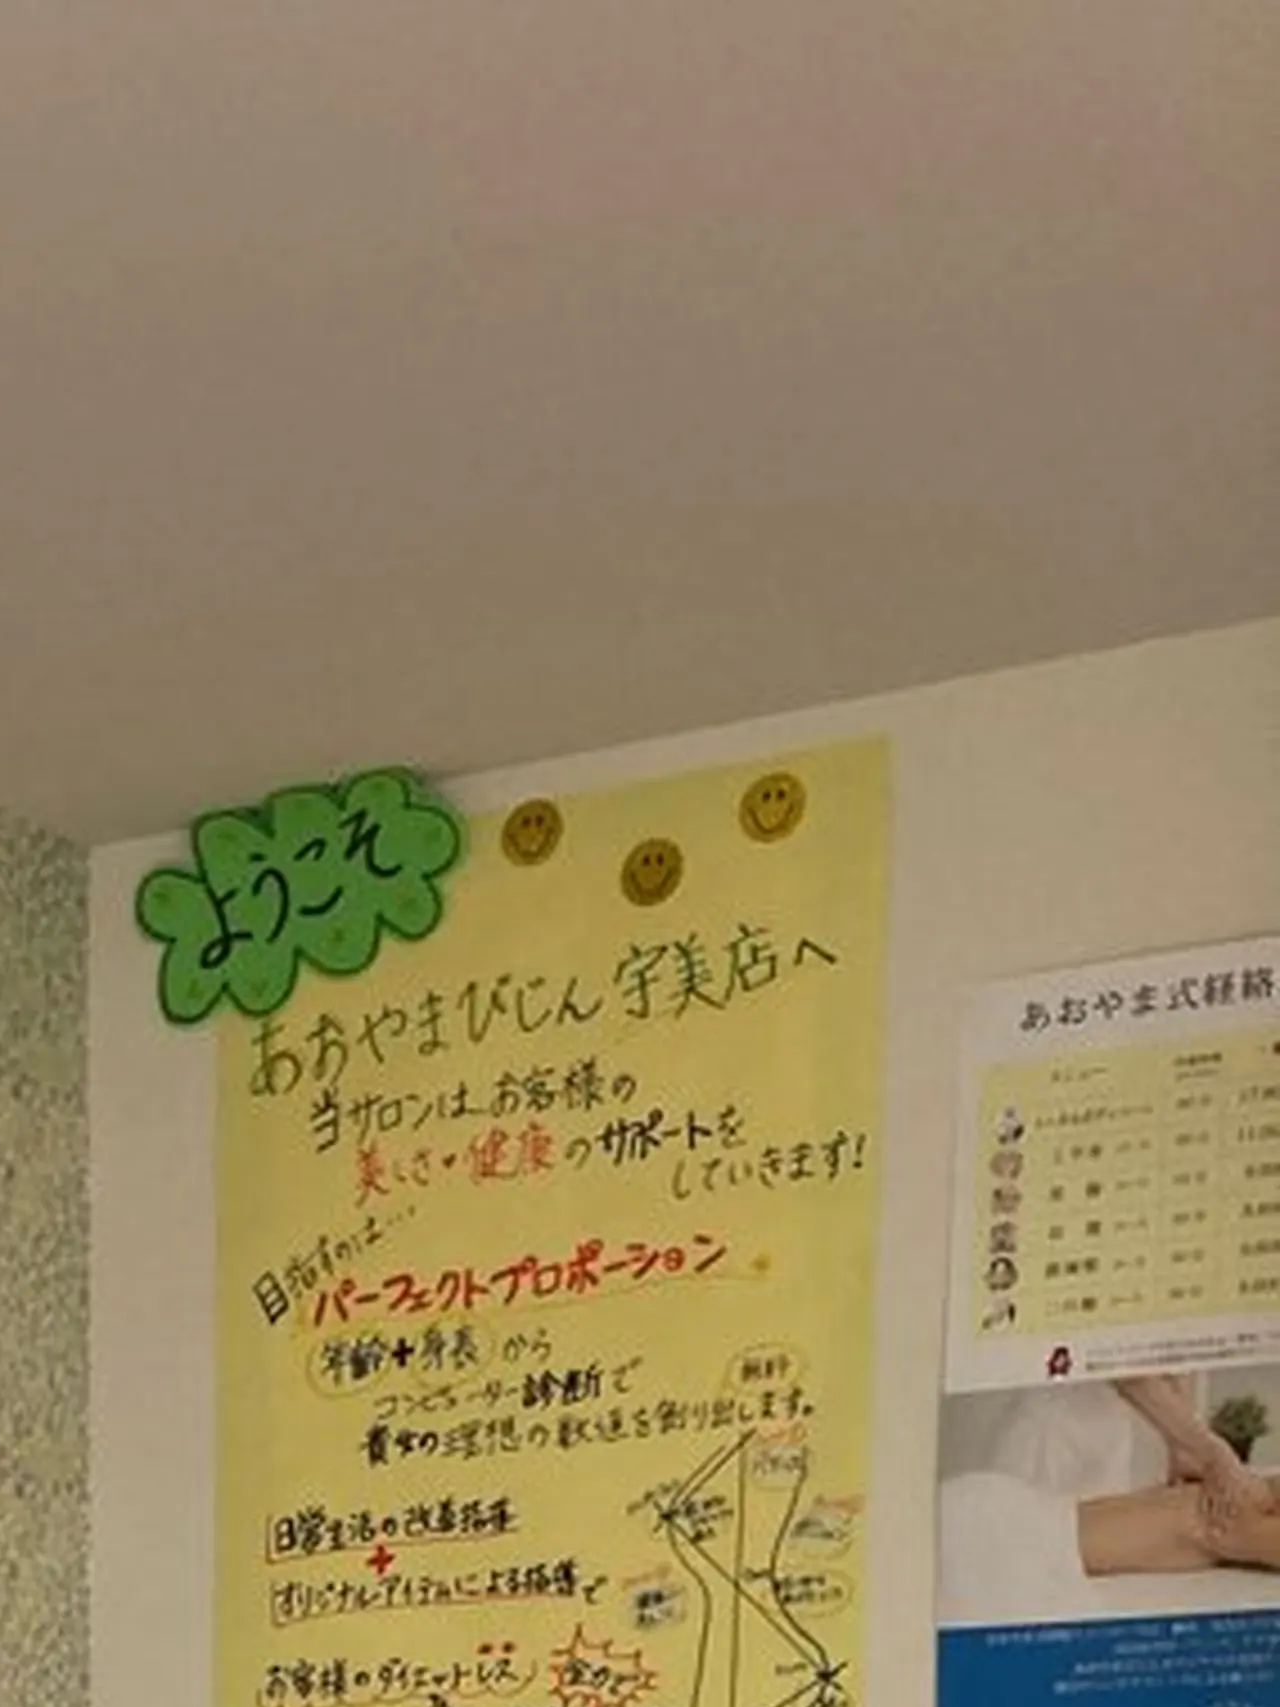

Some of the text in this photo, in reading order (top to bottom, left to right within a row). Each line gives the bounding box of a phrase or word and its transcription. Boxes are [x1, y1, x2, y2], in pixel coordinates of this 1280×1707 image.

[200, 805, 403, 969] ようこそ
[311, 1232, 728, 1328] パーフェクトプロポーション
